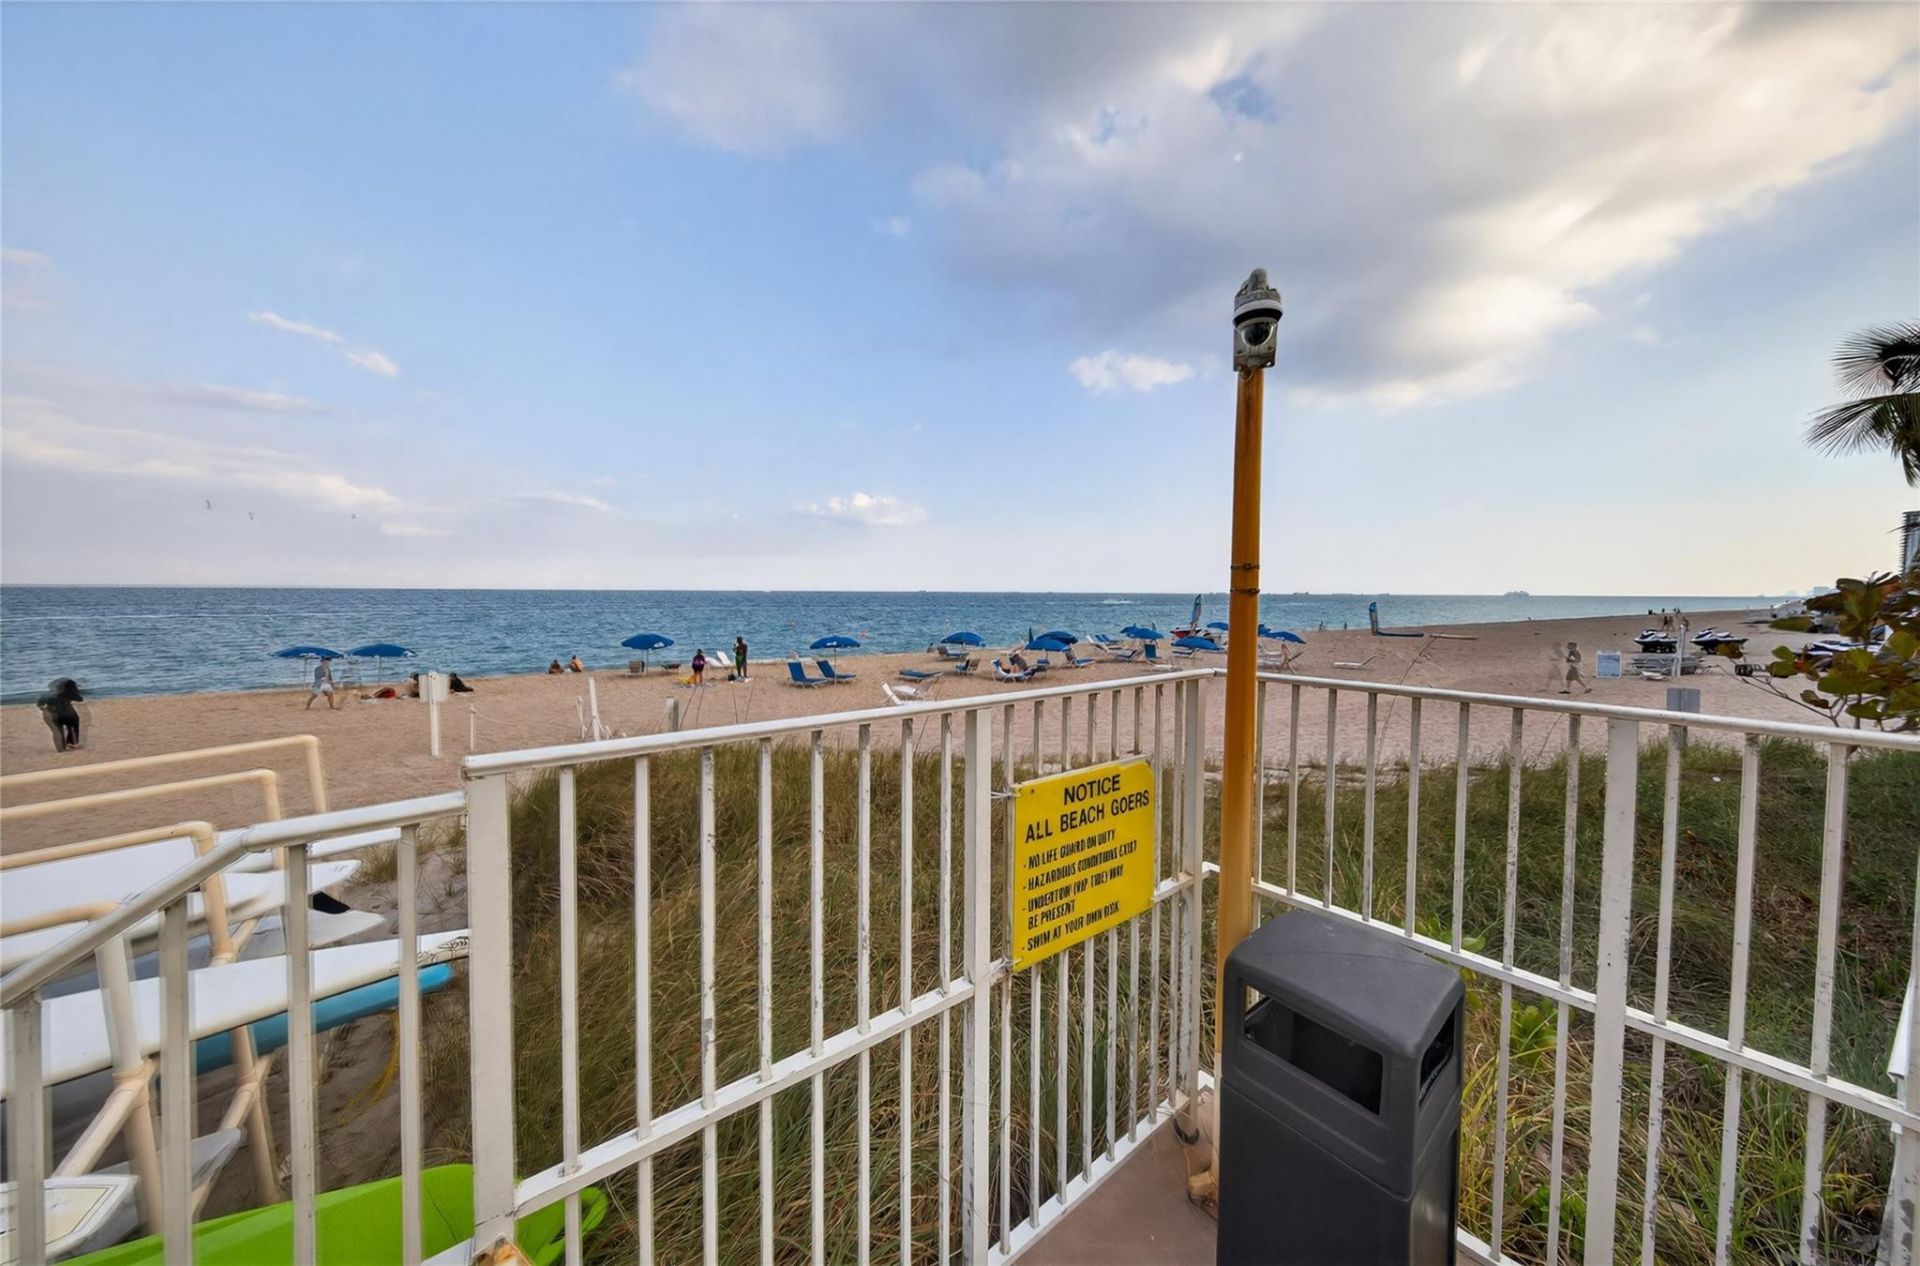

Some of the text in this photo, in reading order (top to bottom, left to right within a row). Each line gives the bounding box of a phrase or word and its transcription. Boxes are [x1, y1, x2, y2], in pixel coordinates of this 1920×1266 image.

[1064, 774, 1121, 805] NOTICE
[1025, 790, 1150, 844] ALL BEACH GOERS
[1028, 829, 1116, 870] NO LIFE GUARD ON DUTY
[1028, 840, 1137, 891] HAZARDOUS CONDITIONS EXIST
[1028, 884, 1072, 912] UNDERTOW
[1028, 900, 1076, 930] BE PRESENT
[1027, 900, 1120, 951] SWIM AT YOUR OWN RISK
